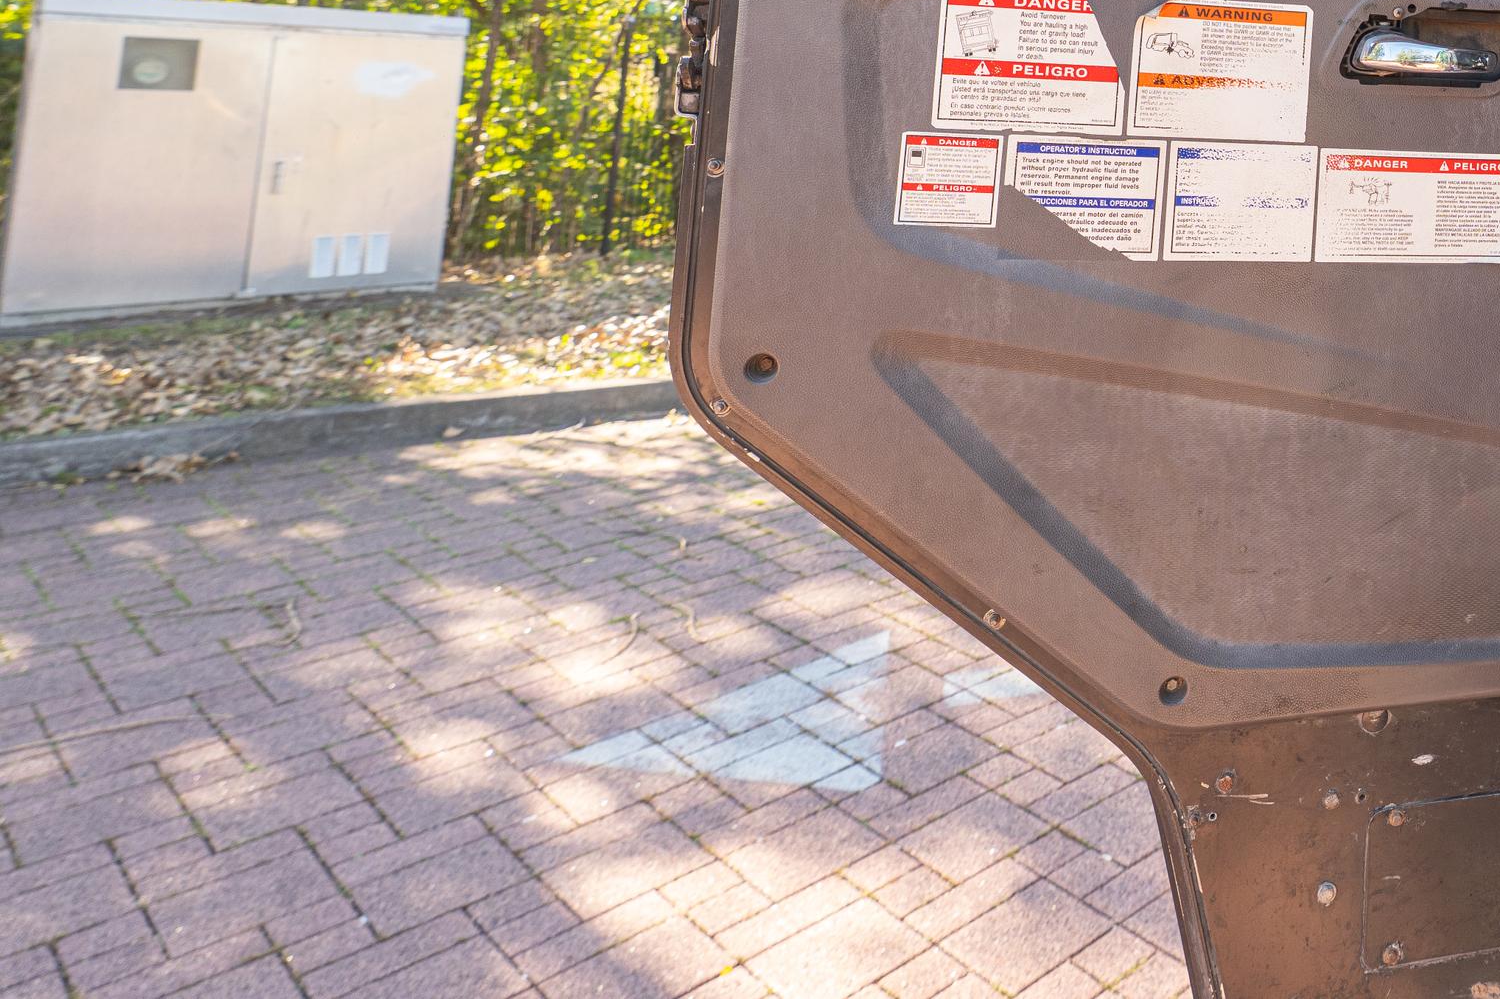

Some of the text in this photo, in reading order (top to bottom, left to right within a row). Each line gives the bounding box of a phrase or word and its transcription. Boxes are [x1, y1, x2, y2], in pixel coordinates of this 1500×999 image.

[1196, 8, 1273, 22] WARNING
[1045, 21, 1067, 30] hauling
[1012, 64, 1088, 78] PELIGRO
[1040, 145, 1137, 156] OPERATOR'S INSTRUCTION
[1354, 160, 1408, 168] DANGER
